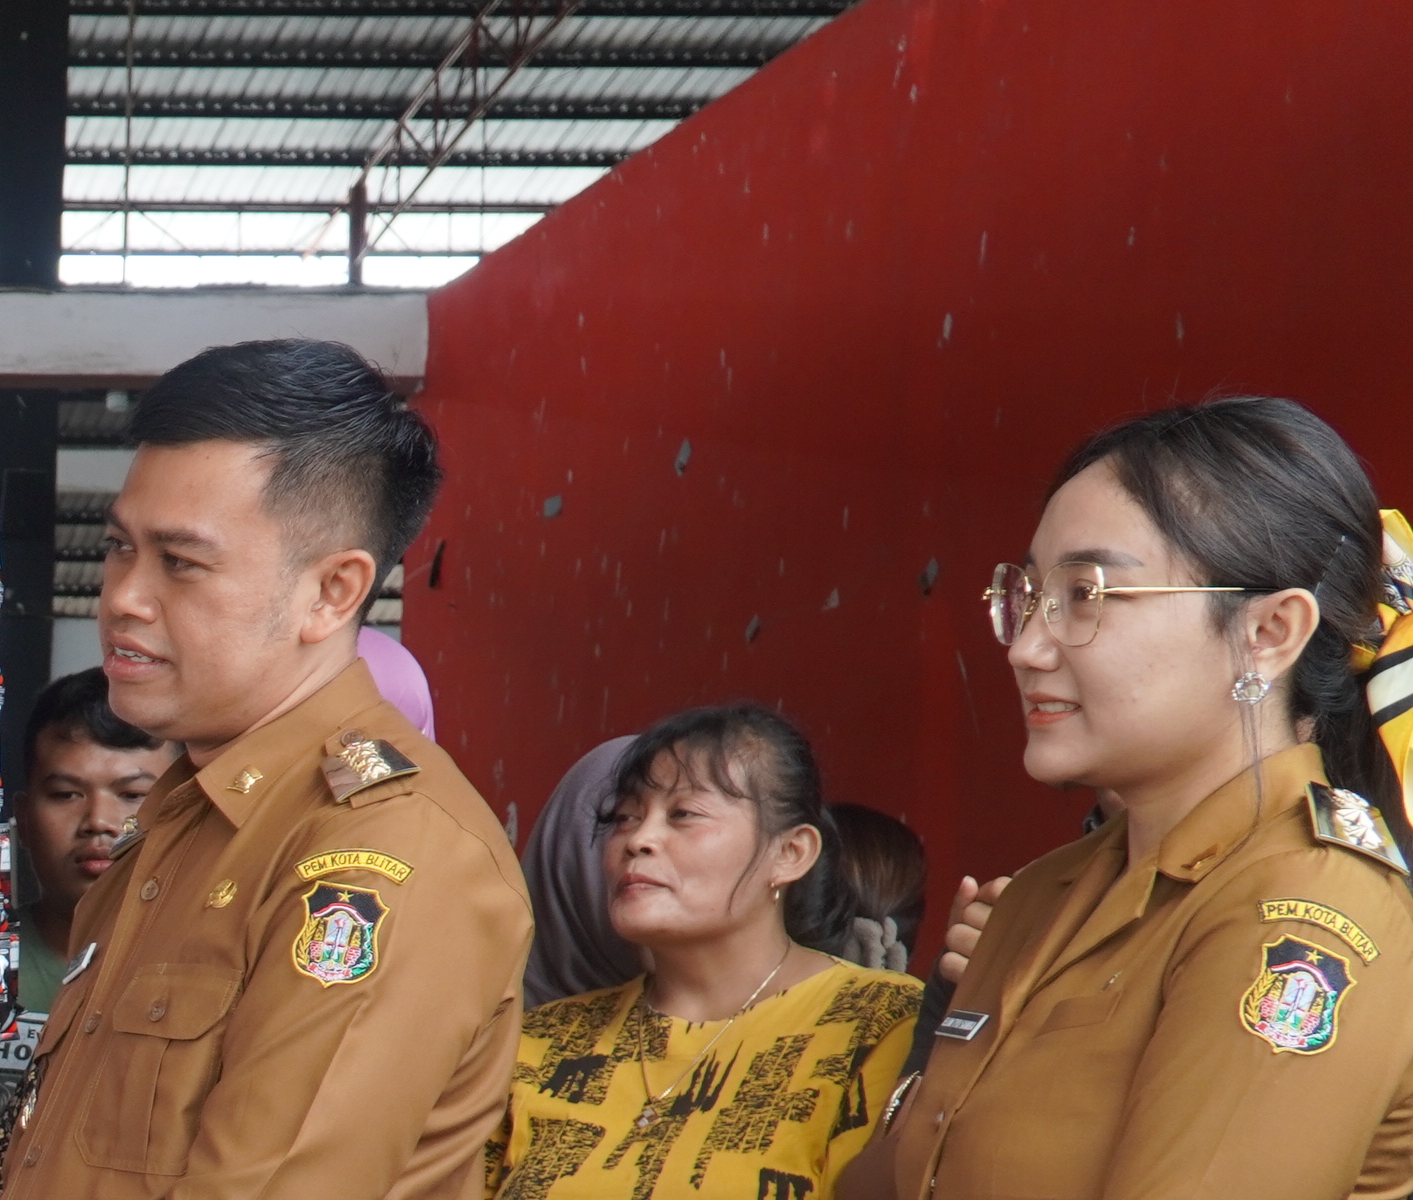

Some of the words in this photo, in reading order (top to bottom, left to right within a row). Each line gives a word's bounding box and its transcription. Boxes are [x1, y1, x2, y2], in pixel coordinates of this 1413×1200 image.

[303, 859, 327, 876] PEM
[330, 853, 361, 868] KOTA
[1267, 903, 1297, 918] PEM
[1304, 905, 1337, 928] KOTA
[1339, 922, 1374, 957] BLITAR
